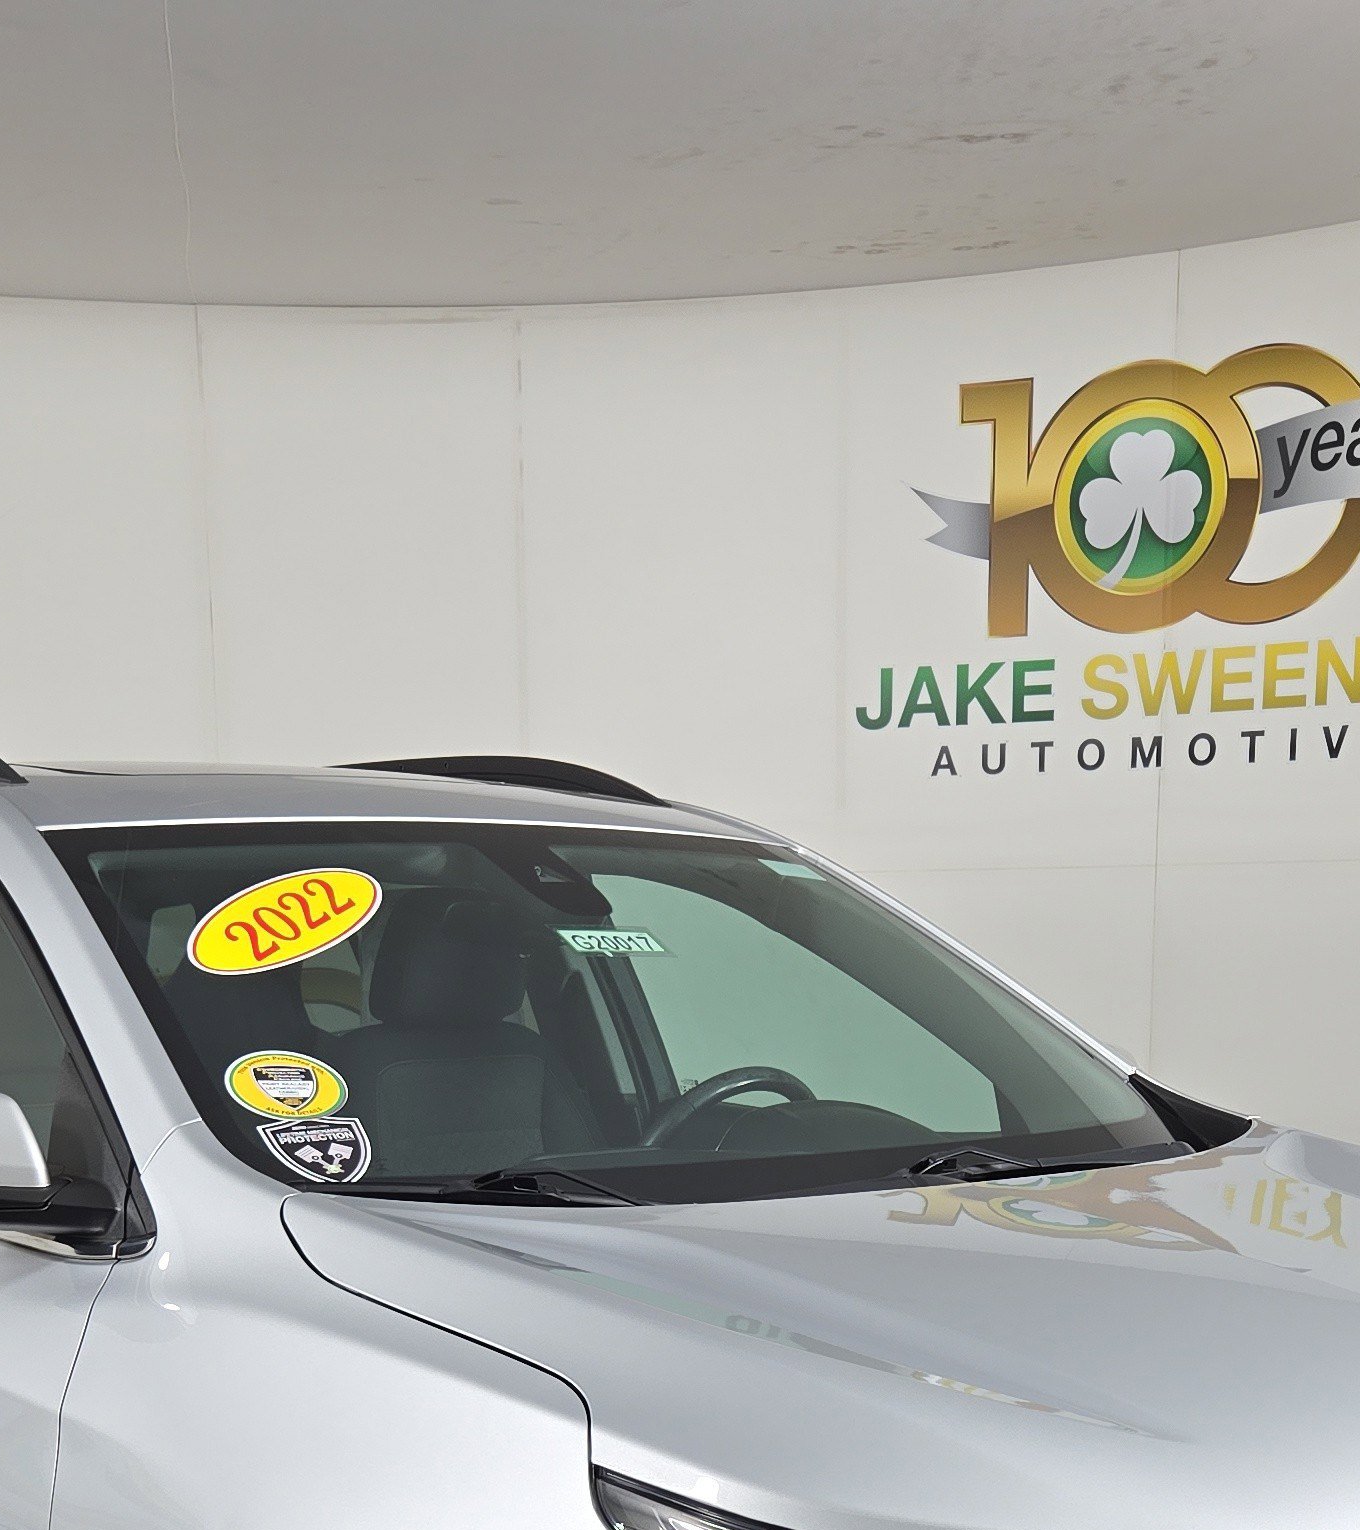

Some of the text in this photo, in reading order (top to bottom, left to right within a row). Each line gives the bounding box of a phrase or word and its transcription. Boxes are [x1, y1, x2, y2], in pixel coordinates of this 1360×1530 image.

[855, 658, 1056, 730] JAKE
[224, 878, 356, 962] 2022
[571, 934, 655, 951] G20017
[279, 1131, 355, 1145] PROTECTION
